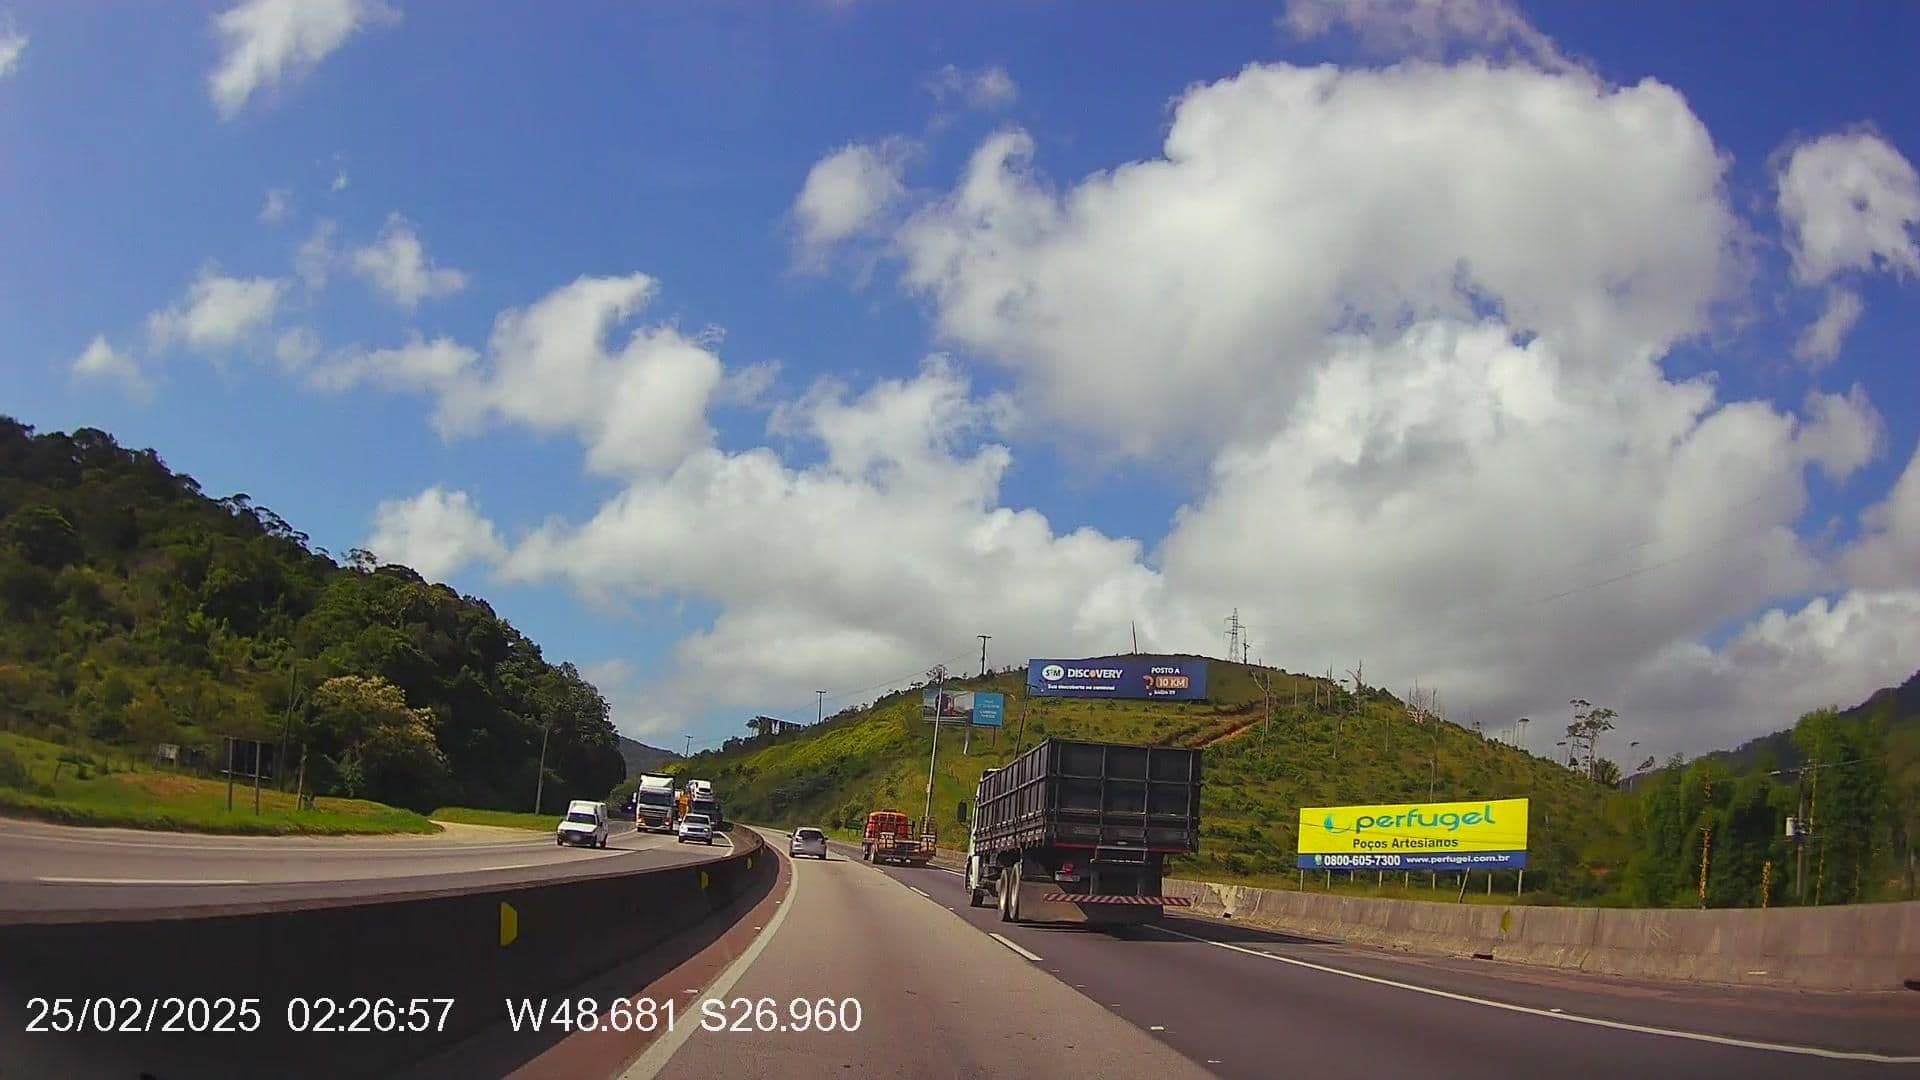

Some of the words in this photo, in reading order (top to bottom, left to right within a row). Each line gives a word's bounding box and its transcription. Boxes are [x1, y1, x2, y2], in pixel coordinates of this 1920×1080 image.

[1067, 668, 1123, 679] DISCOVERY
[1158, 678, 1169, 687] 10
[1170, 678, 1186, 687] KM
[1356, 805, 1496, 834] perfugel
[1353, 839, 1388, 850] Poços
[1391, 838, 1459, 848] Artesianos
[1323, 855, 1401, 866] 0800-605-7300
[1406, 855, 1511, 864] www.perfugel.com.br
